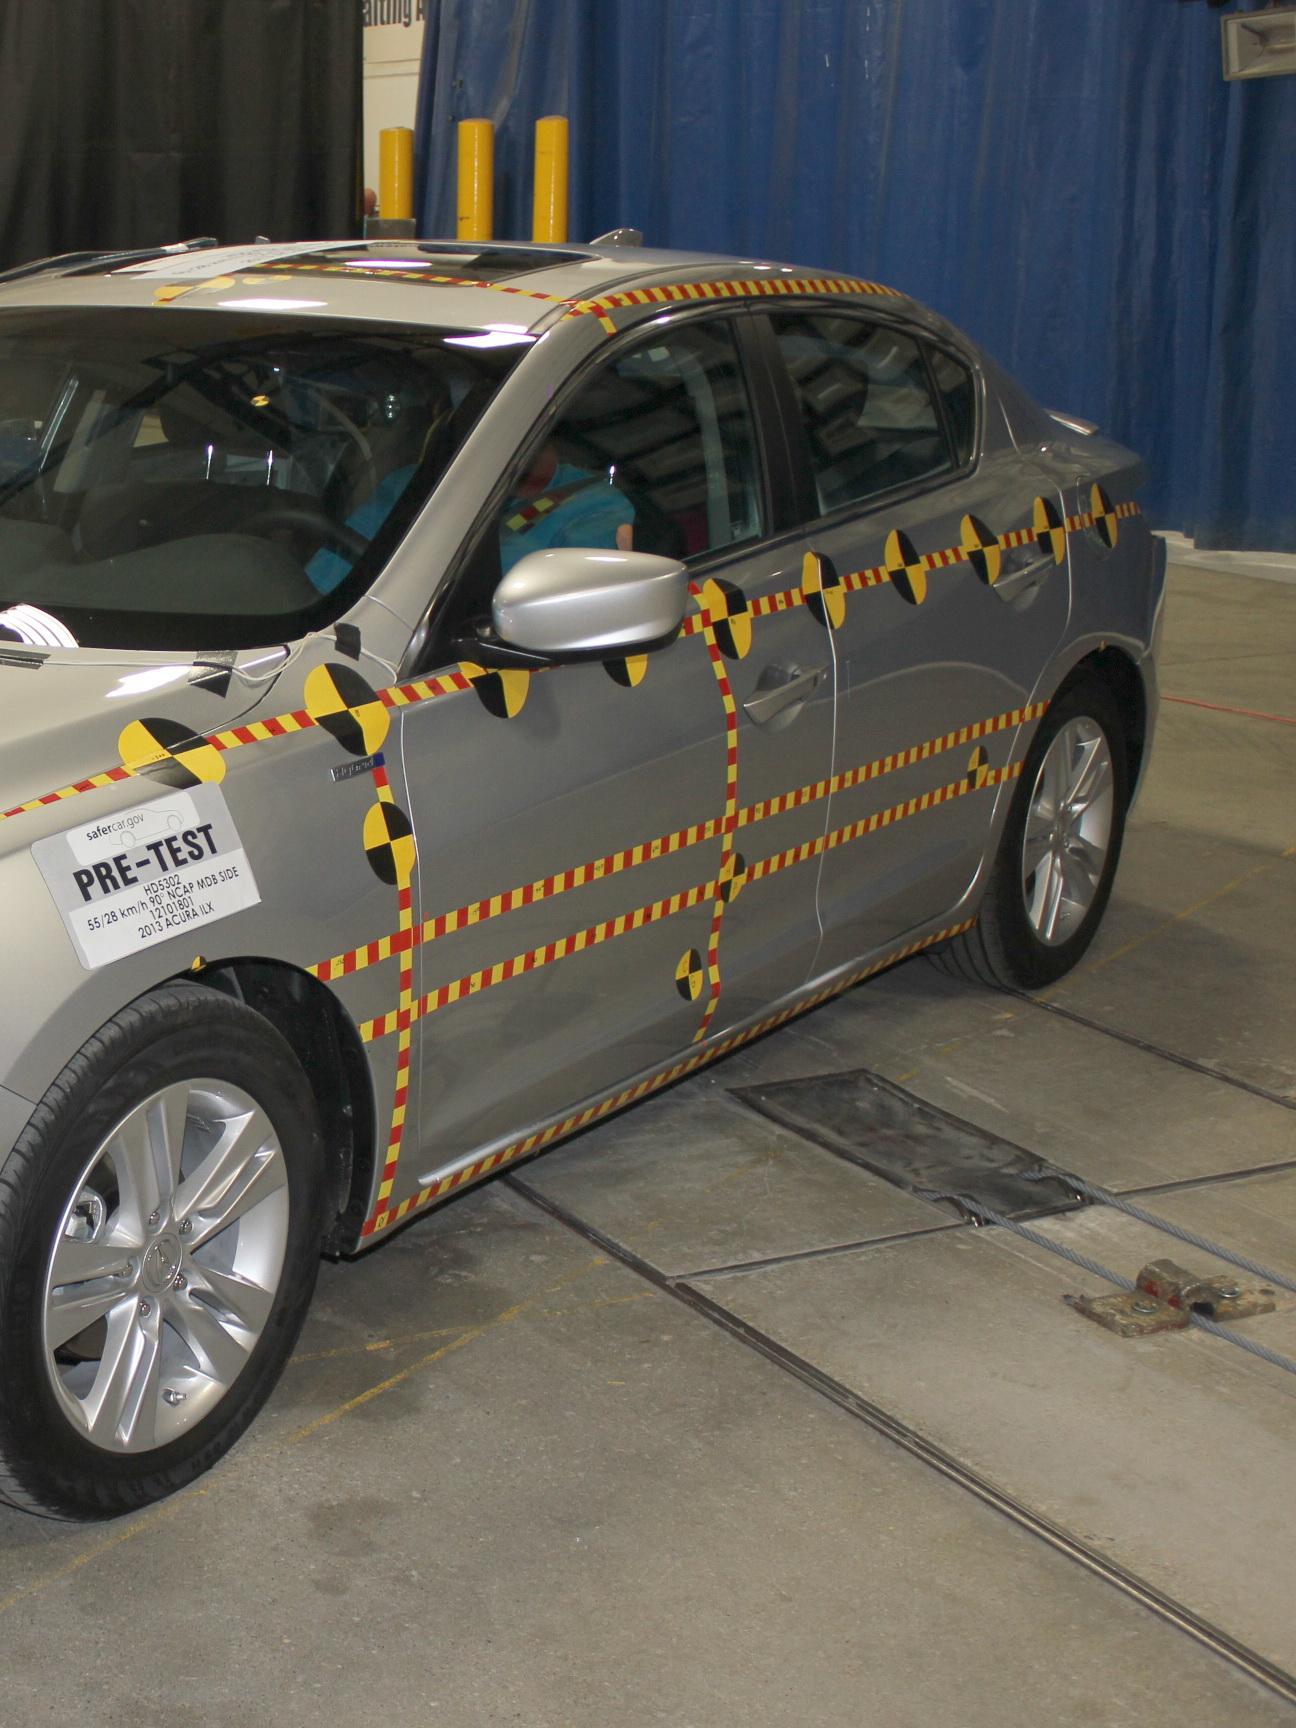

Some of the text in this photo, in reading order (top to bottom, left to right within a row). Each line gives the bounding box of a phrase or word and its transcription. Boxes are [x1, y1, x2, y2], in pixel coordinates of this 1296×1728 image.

[86, 814, 144, 842] safercar.gov
[73, 824, 218, 902] PRE-TEST
[87, 911, 119, 931] 55/28
[120, 898, 149, 919] km/h
[167, 882, 195, 902] NCAP
[197, 874, 218, 894] MDB
[218, 866, 239, 884] SIDE
[143, 874, 182, 896] HD5302
[138, 901, 215, 939] 2013 ACURA ILX
[149, 896, 195, 920] 12101801
